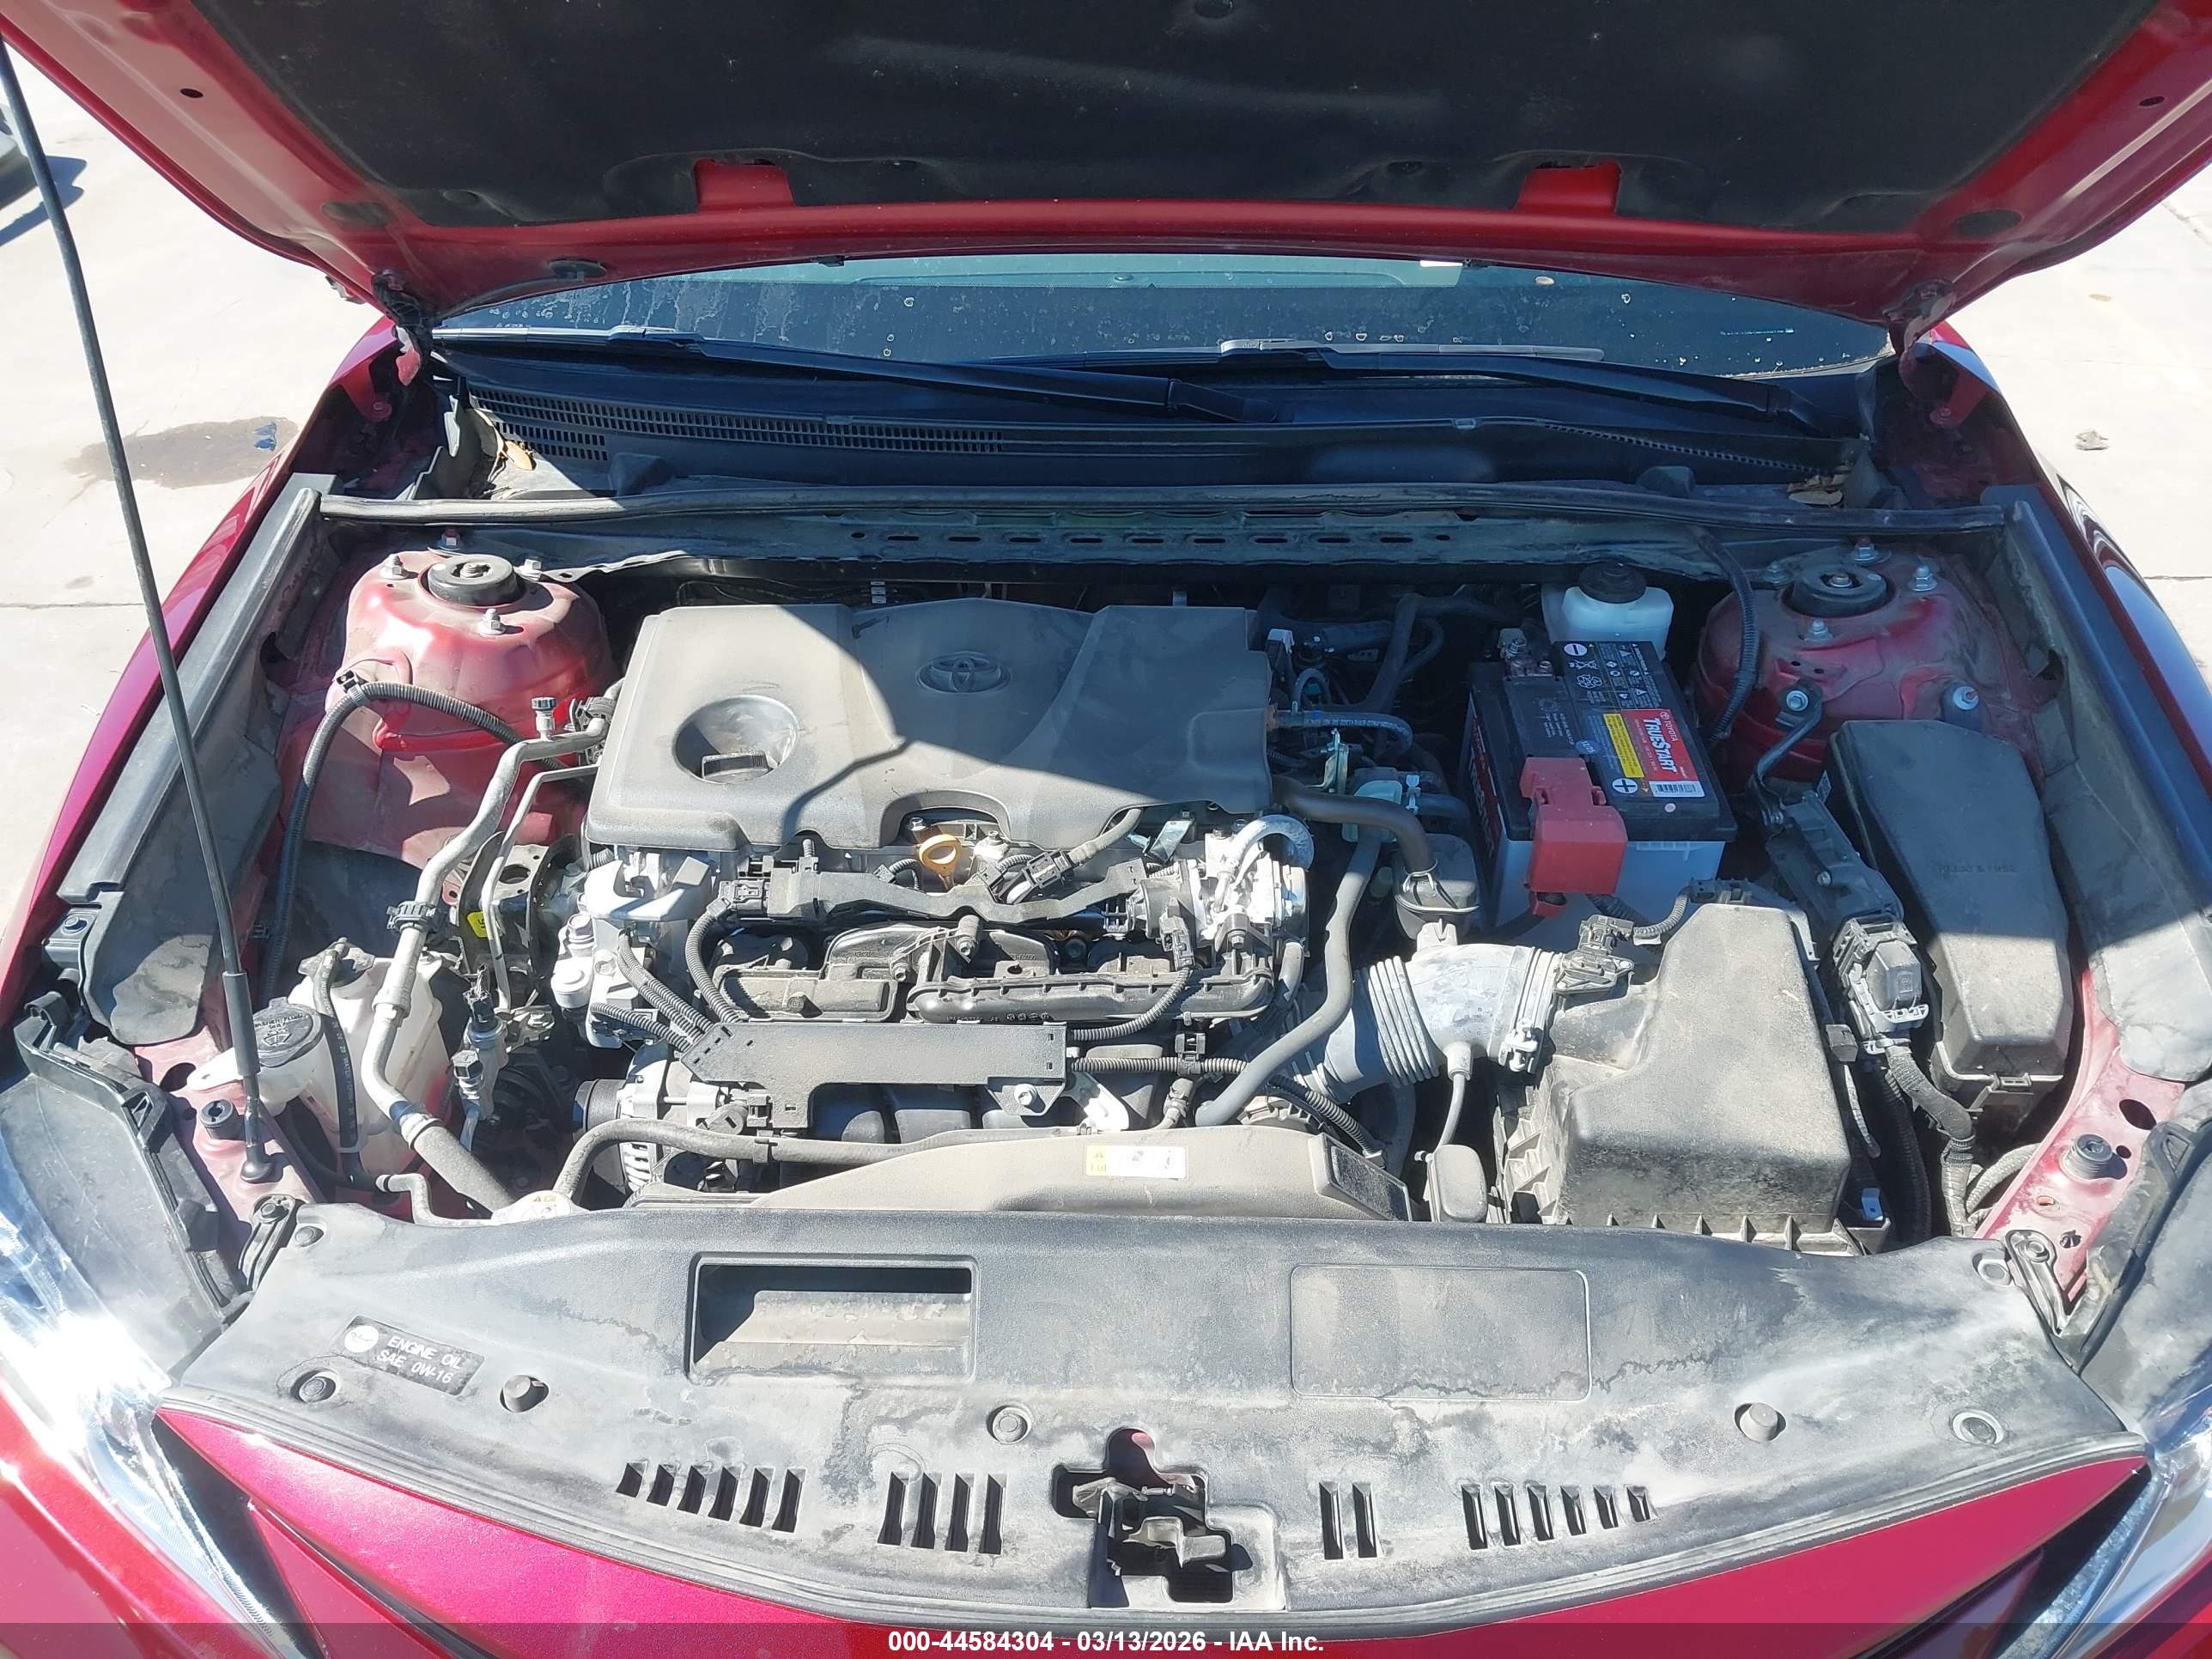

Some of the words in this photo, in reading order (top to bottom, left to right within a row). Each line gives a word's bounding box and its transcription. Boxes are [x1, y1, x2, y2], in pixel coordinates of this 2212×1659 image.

[1642, 717, 1677, 773] TRUESTART
[1664, 720, 1679, 742] TOYOTA
[377, 1349, 407, 1368] SAE
[410, 1362, 454, 1383] 0W-16
[386, 1335, 438, 1360] ENGINE
[441, 1353, 461, 1370] OIL
